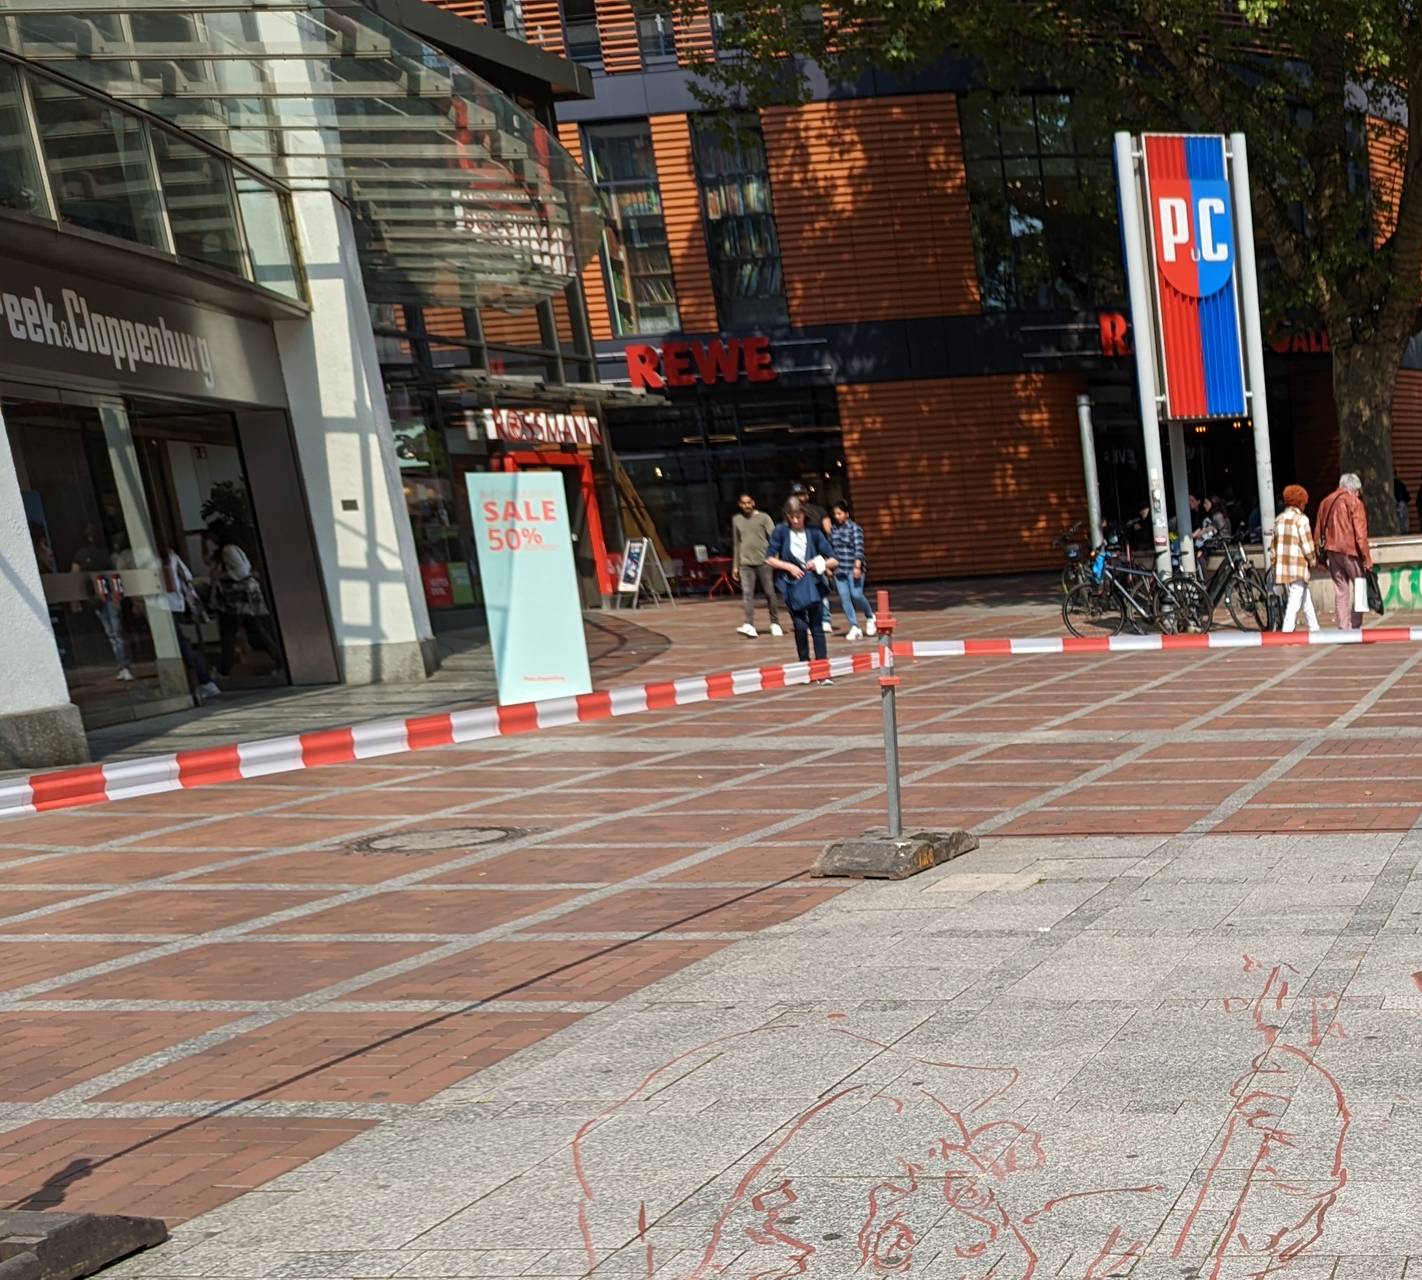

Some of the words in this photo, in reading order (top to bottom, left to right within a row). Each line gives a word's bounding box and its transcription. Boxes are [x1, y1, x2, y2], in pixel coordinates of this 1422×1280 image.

[624, 336, 778, 390] REWE
[483, 500, 557, 522] SALE
[488, 527, 543, 552] 50%
